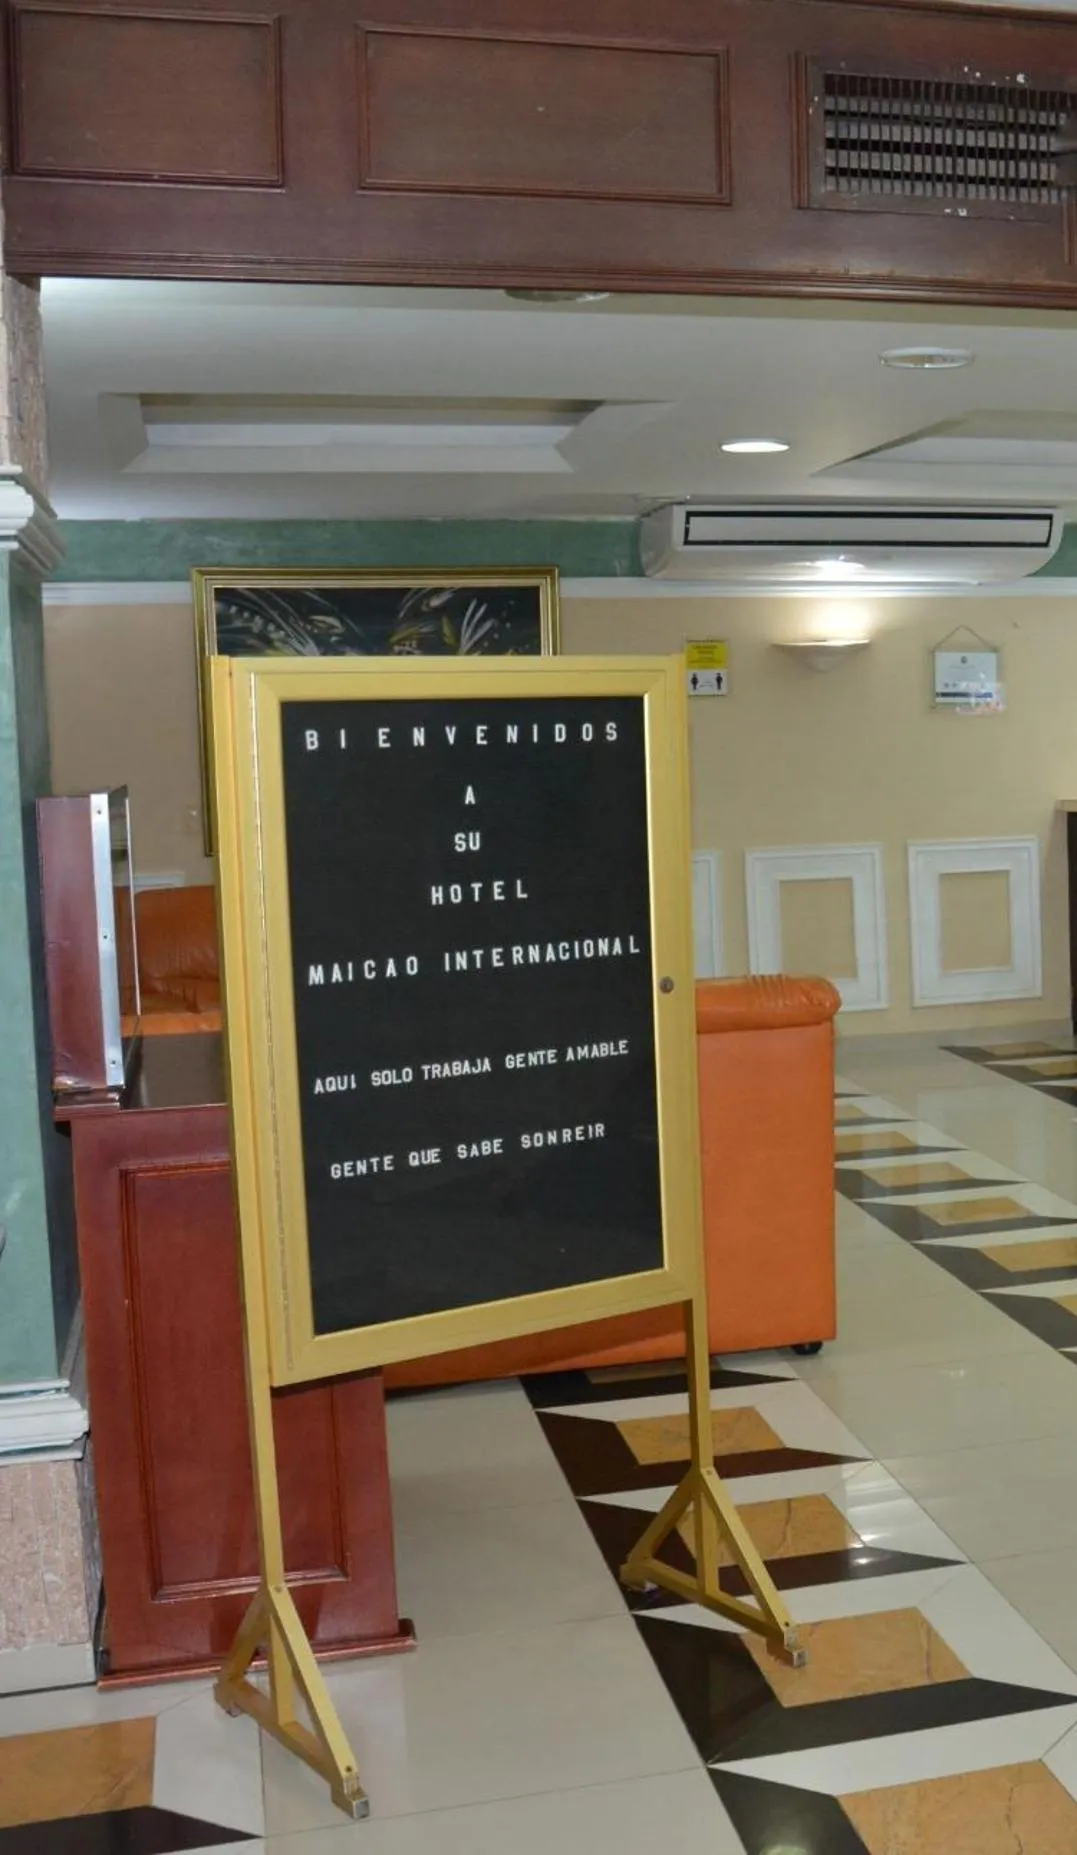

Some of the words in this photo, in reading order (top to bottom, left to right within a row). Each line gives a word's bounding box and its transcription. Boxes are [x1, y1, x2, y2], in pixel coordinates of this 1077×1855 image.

[303, 721, 619, 752] BIENVENIDOS
[464, 785, 477, 806] A
[453, 831, 481, 853] SU
[430, 879, 529, 907] HOTEL
[307, 954, 420, 987] MAICAO
[444, 935, 641, 973] INTERNACIONAL
[313, 1073, 357, 1095] AQUI
[370, 1066, 413, 1087] SOLO
[421, 1057, 492, 1082] TRABAJA
[504, 1048, 558, 1070] GENTE
[565, 1039, 629, 1062] AMABLE
[330, 1154, 395, 1180] GENTE
[407, 1147, 442, 1167] QUE
[456, 1138, 504, 1160] SABE
[520, 1122, 606, 1149] SONREIR
